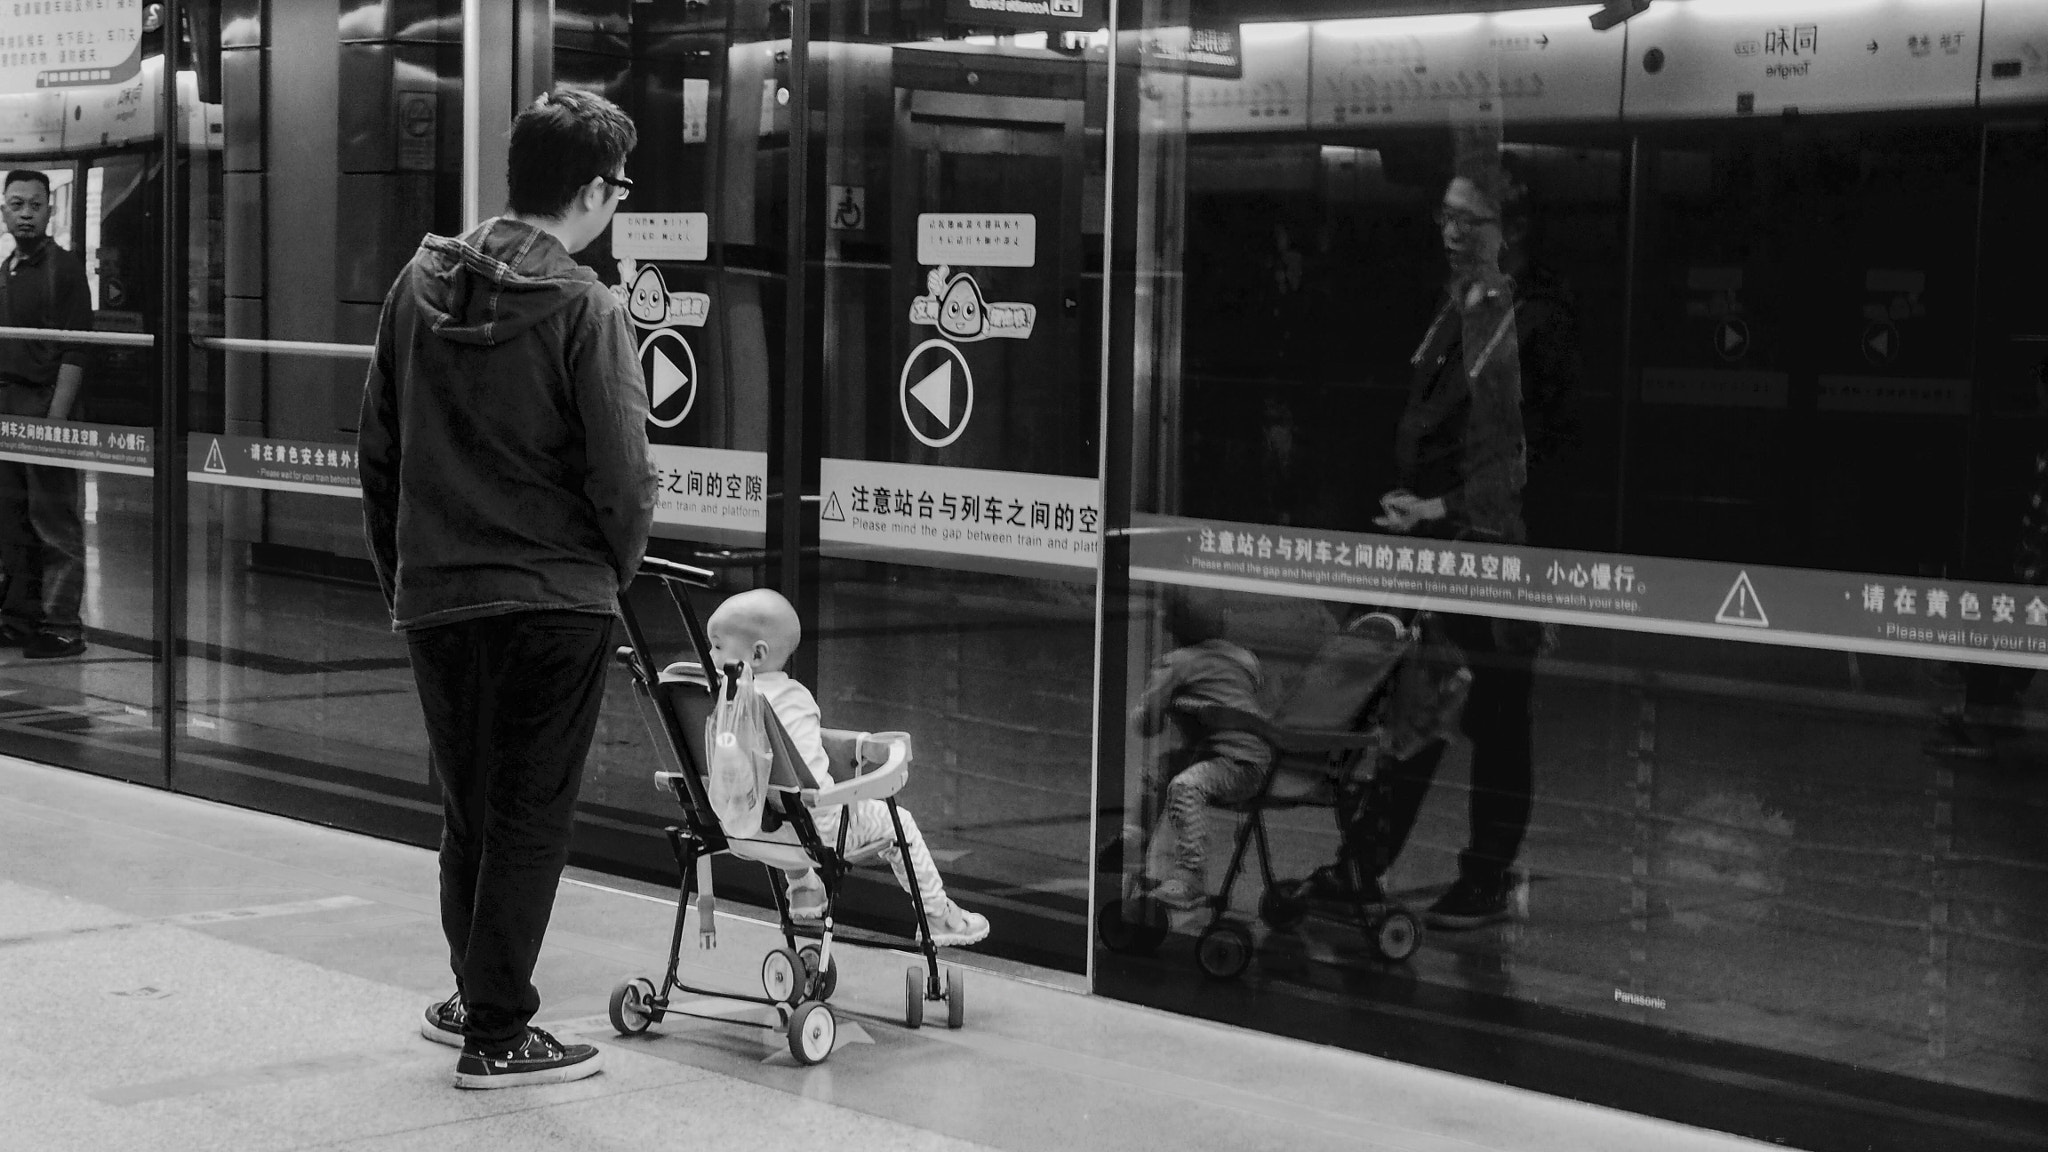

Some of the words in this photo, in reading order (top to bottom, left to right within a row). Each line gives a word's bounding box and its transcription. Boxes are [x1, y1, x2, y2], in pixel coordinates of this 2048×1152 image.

[0, 421, 150, 452] 列车之间的高度差及空隙，小心慢行。
[676, 501, 697, 512] train
[701, 503, 718, 514] and
[851, 485, 1098, 535] 注意站台与列车之间的空
[852, 516, 887, 533] Please
[891, 521, 917, 534] mind
[921, 524, 938, 537] the
[942, 528, 962, 541] gap
[967, 529, 1013, 545] between
[1017, 533, 1042, 547] train
[1047, 537, 1068, 550] and
[1199, 527, 1646, 594] 注意站台与列车之间的高度差及空隙，小心慢行。
[1191, 556, 1221, 570] Please
[1223, 561, 1244, 573] mind
[1247, 562, 1262, 574] the
[1263, 566, 1281, 578] gap
[1281, 567, 1300, 578] and
[1301, 568, 1330, 583] height
[1331, 571, 1379, 587] difference
[1381, 576, 1423, 590] between
[1425, 580, 1447, 593] train
[1449, 583, 1468, 595] and
[1517, 587, 1553, 604] Please
[1555, 593, 1586, 606] watch
[1589, 596, 1612, 610] your
[1862, 583, 2048, 627] 请在黄色安全
[1886, 621, 1934, 642] Please
[1937, 629, 1966, 645] wait
[1970, 630, 1989, 646] for
[1992, 635, 2024, 652] your
[1614, 988, 1666, 1010] Panasonic
